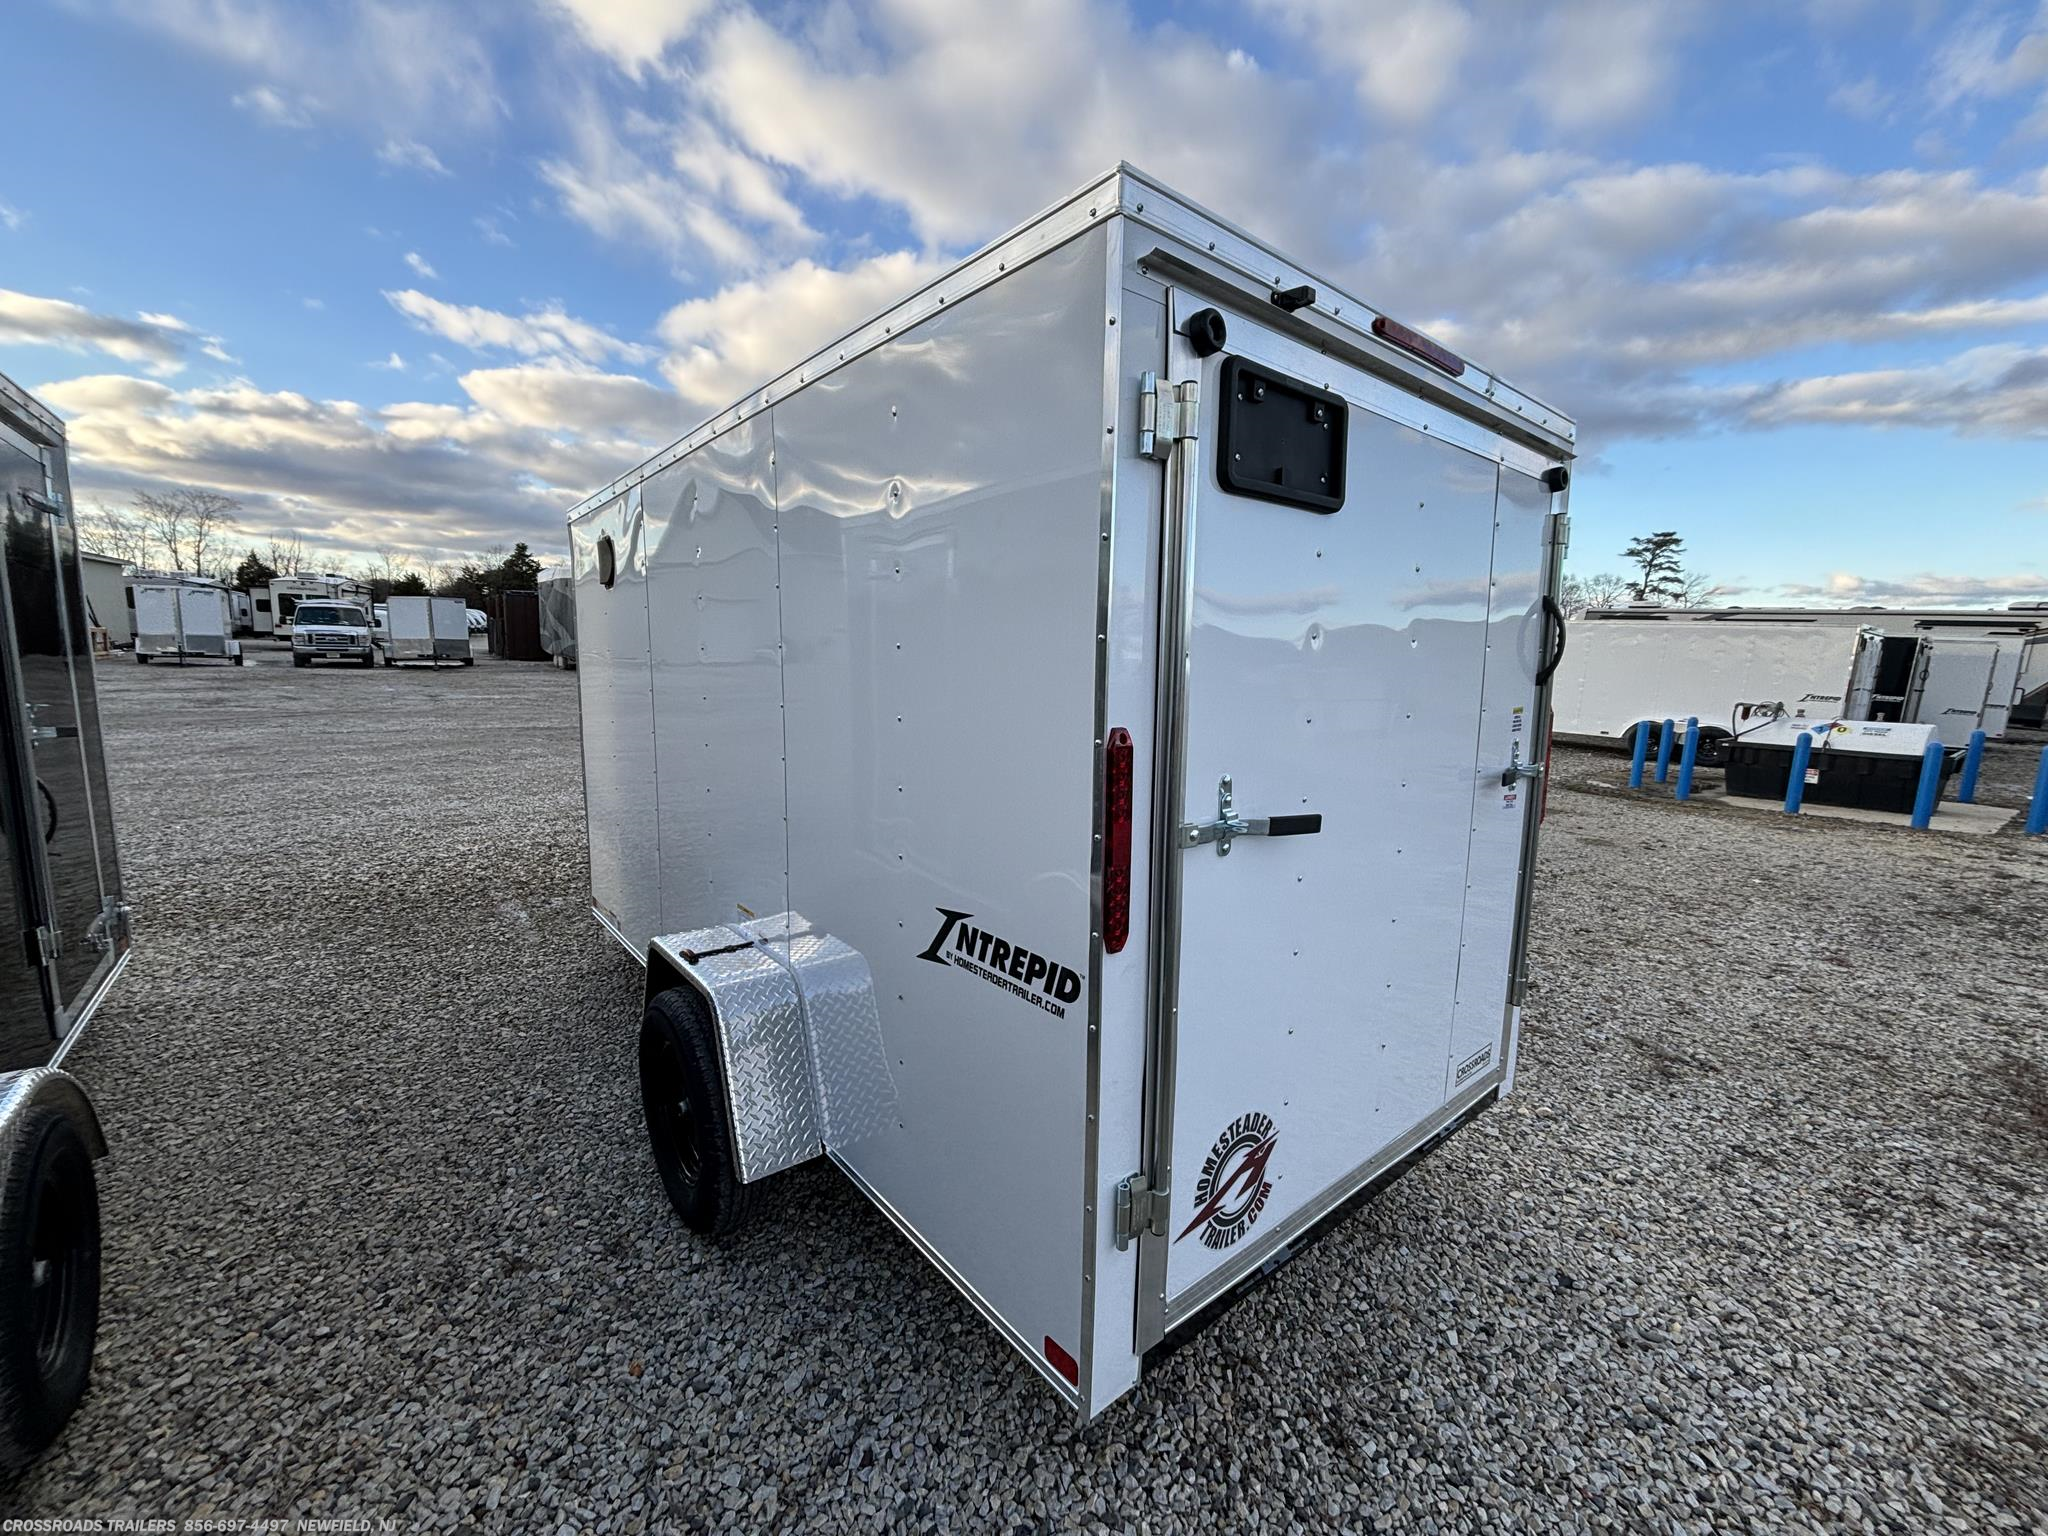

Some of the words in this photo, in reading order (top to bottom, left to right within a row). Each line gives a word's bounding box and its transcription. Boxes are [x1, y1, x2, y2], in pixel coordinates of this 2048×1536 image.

[916, 907, 1081, 1004] INTREPID
[954, 956, 1066, 1020] HOMESTEADERTRAILER.COM
[1194, 1112, 1273, 1209] HOMESTEADER
